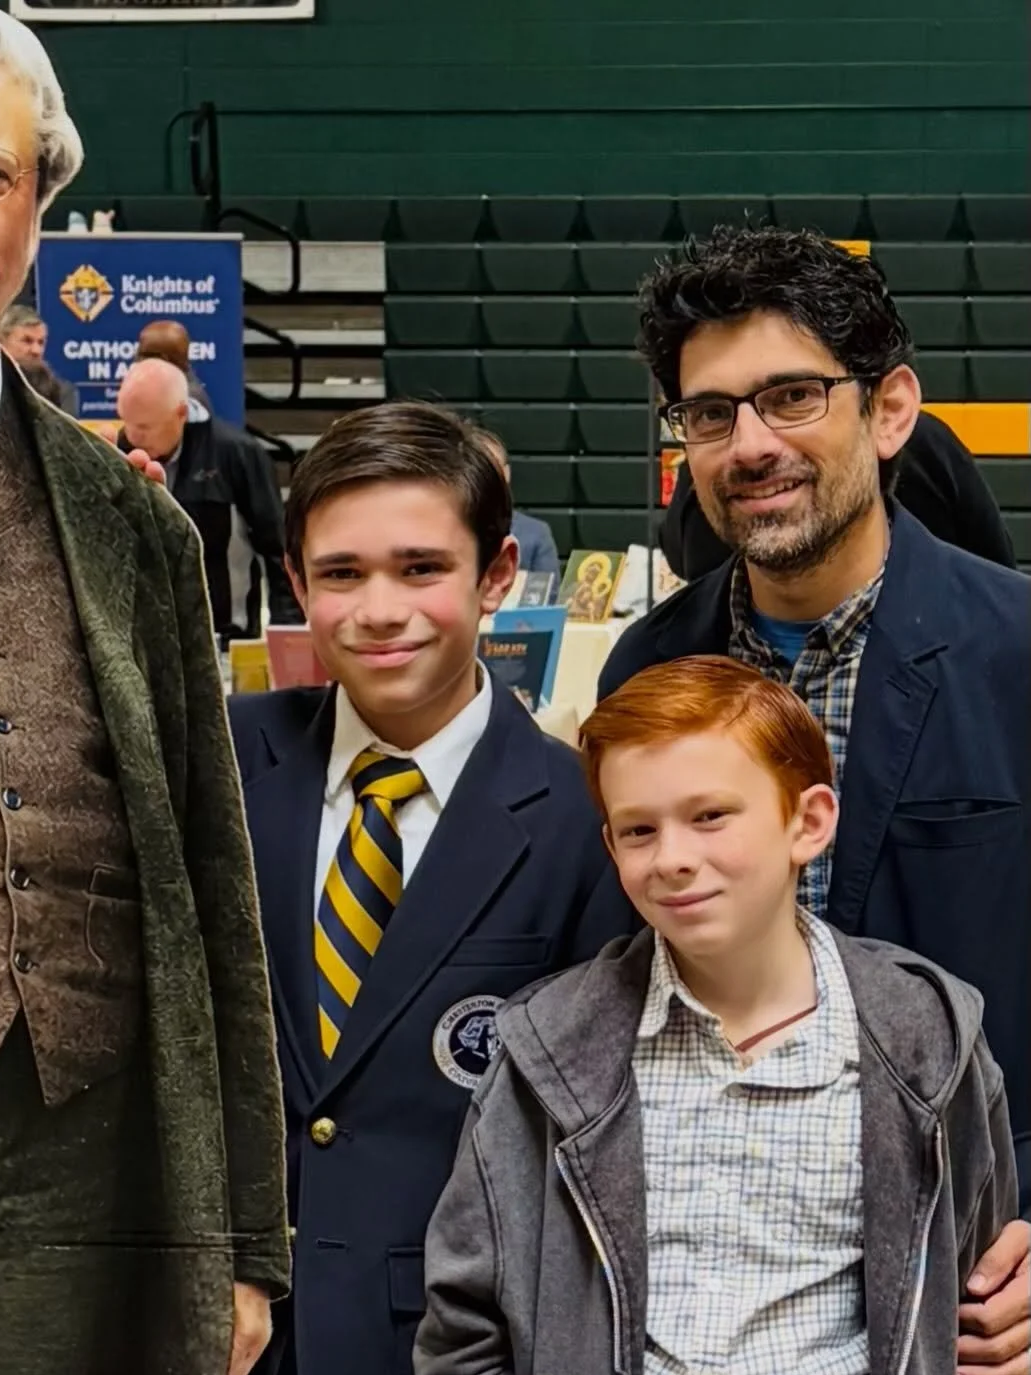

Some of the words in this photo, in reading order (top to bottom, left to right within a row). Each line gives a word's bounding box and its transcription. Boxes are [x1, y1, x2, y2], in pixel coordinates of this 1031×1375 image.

[121, 275, 191, 298] Knights
[194, 275, 215, 294] of
[88, 363, 111, 379] IN
